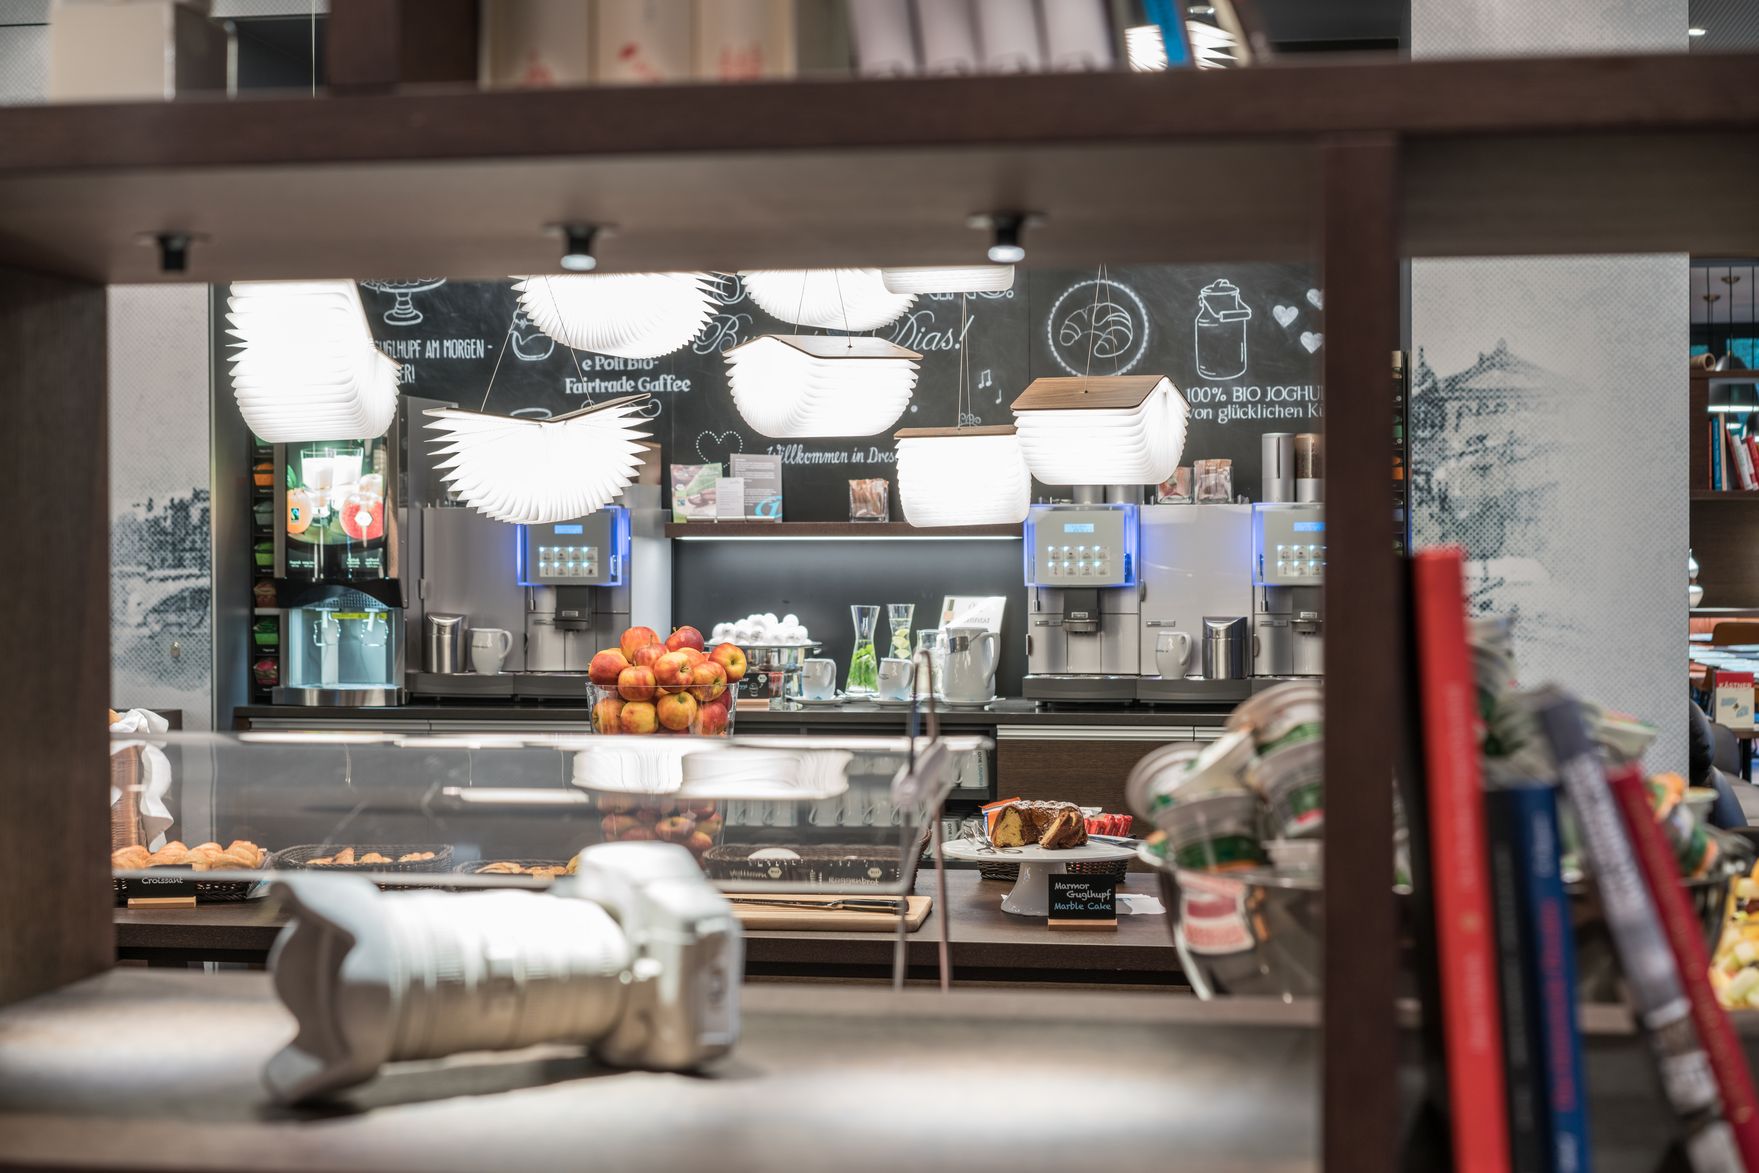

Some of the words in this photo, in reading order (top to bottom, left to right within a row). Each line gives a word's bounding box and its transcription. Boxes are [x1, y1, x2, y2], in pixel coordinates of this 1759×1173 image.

[425, 340, 440, 359] AM
[443, 339, 485, 359] MORGEN
[564, 376, 636, 394] Fairtrade
[1185, 386, 1227, 403] 100%
[1232, 386, 1261, 402] BIO
[1217, 403, 1303, 424] glücklichen
[766, 444, 848, 464] Willkommen
[851, 447, 864, 463] in
[866, 447, 898, 464] Dres
[141, 875, 183, 884] Croissant
[1054, 882, 1090, 890] Marmor
[1066, 888, 1112, 903] Guglhupf
[1054, 901, 1085, 911] Marble
[1087, 902, 1112, 911] Cake
